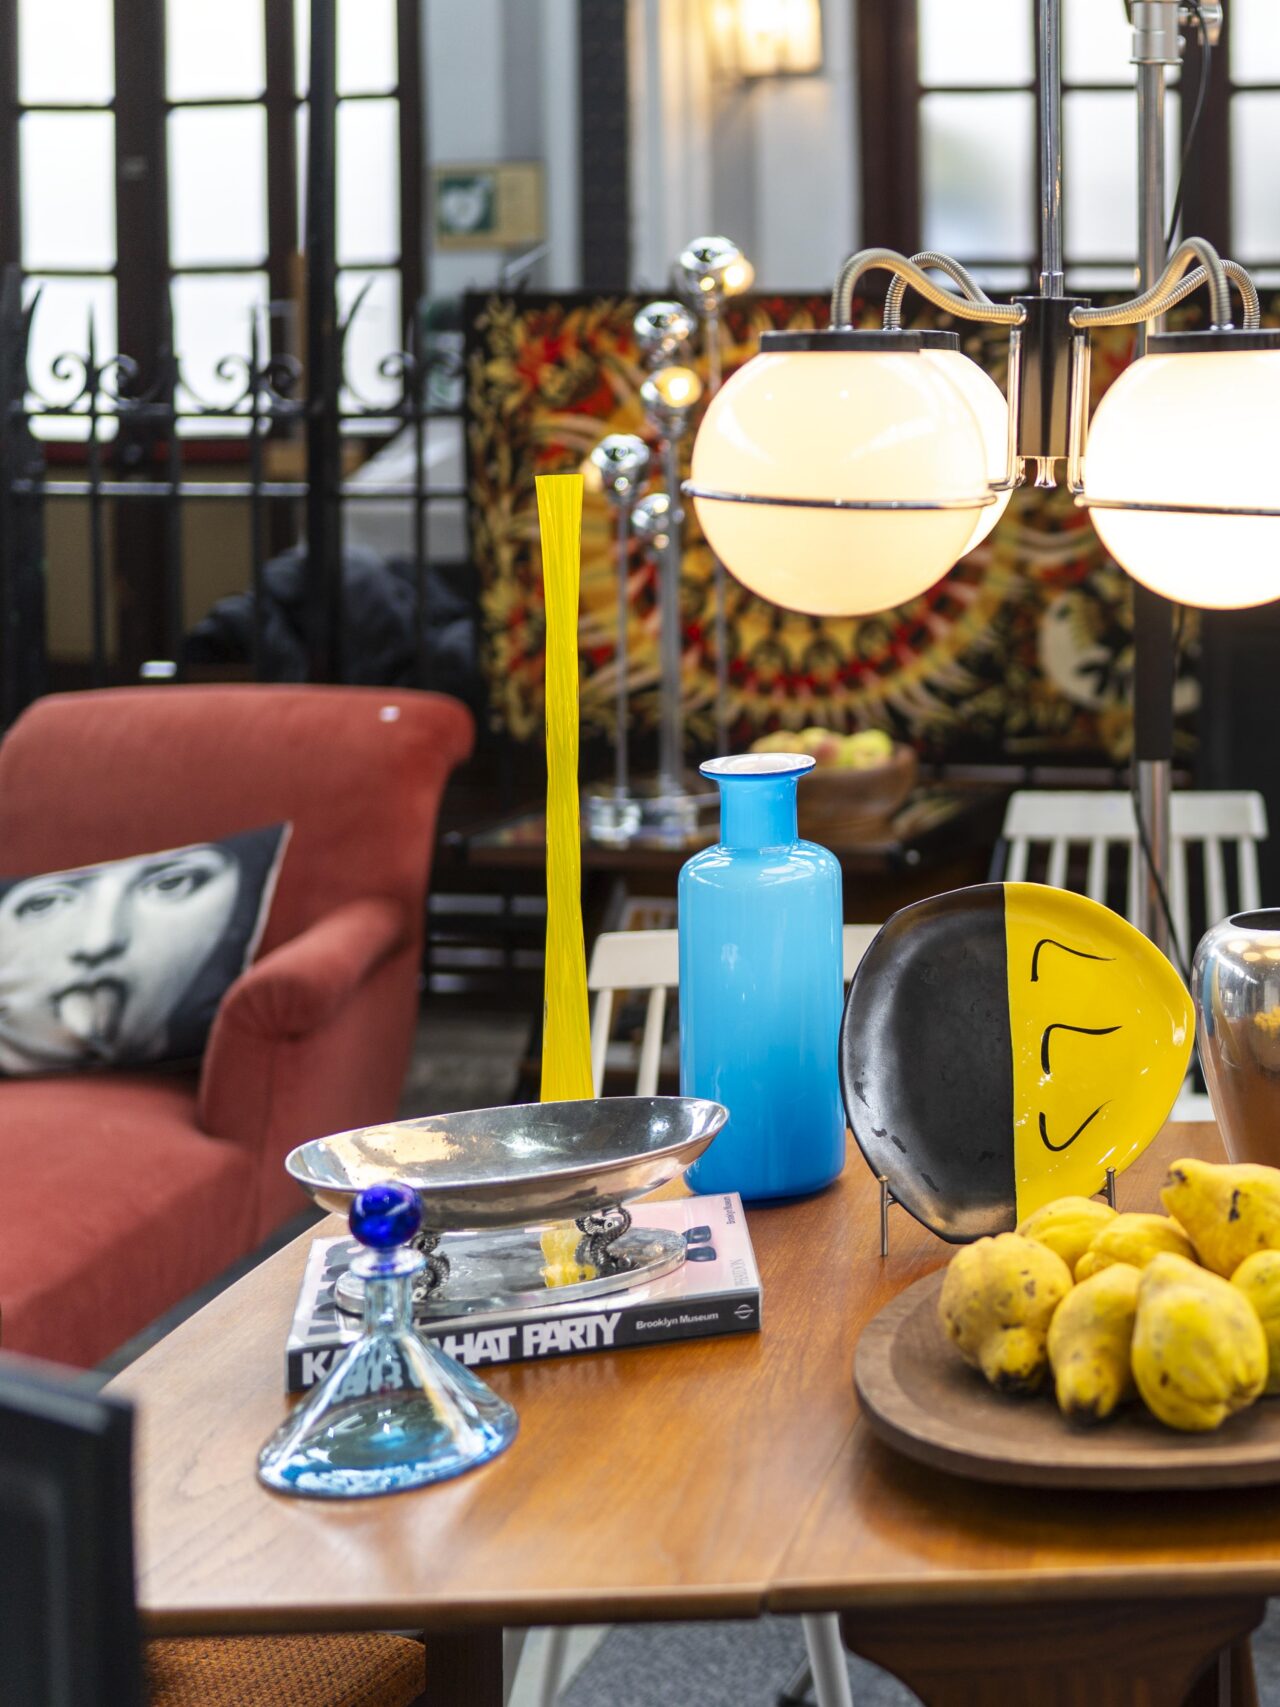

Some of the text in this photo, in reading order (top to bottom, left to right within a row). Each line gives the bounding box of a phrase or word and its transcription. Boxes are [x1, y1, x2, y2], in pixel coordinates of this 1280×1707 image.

[522, 1312, 622, 1358] PARTY
[636, 1312, 719, 1331] Brooklyn Museum
